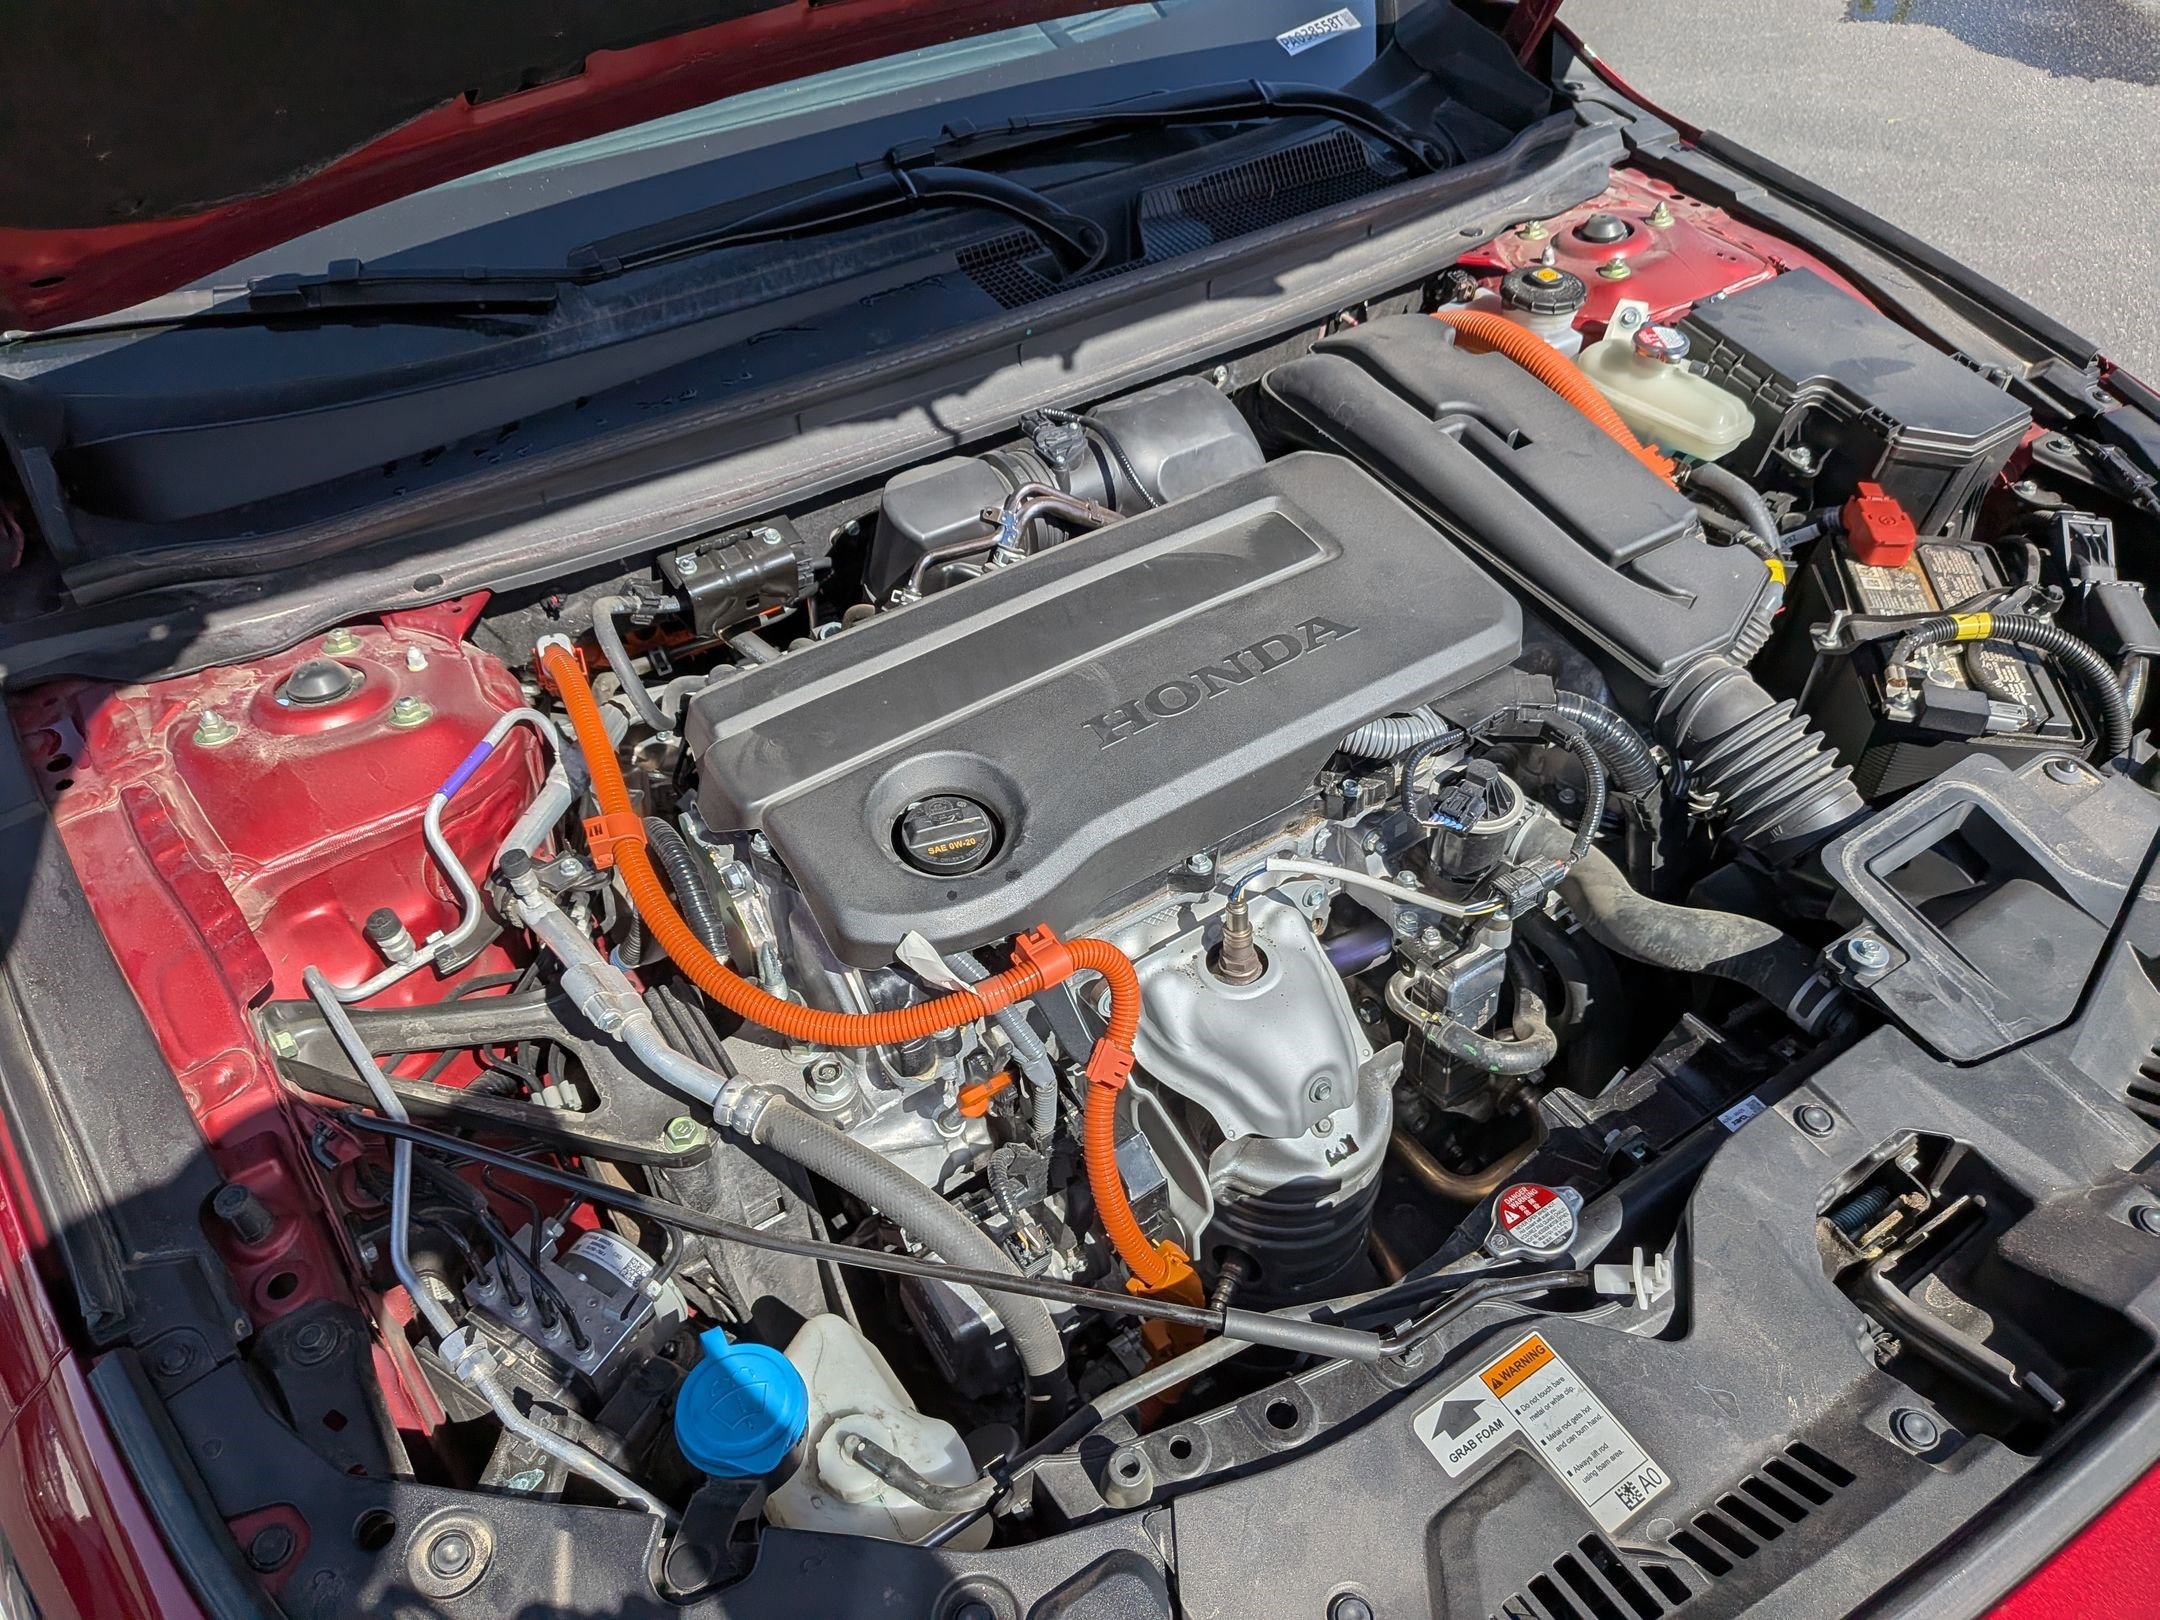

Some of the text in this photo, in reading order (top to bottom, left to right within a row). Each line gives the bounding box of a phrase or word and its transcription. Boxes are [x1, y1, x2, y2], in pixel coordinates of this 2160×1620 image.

[1080, 616, 1360, 750] HONDA
[928, 843, 948, 855] SAE
[948, 838, 976, 851] 0W-20
[1504, 1186, 1529, 1205] DANGER
[1499, 1344, 1546, 1383] WARNING
[1520, 1377, 1565, 1411] Do not touch bare
[1530, 1408, 1545, 1421] metal
[1544, 1403, 1551, 1411] or
[1550, 1393, 1564, 1405] white
[1449, 1418, 1504, 1463] GRAB FOAM
[1546, 1405, 1592, 1442] Metal rod gets hot
[1556, 1413, 1604, 1452] and can burn hand.
[1573, 1442, 1608, 1473] Always lift rod
[1582, 1449, 1624, 1483] using foam area.
